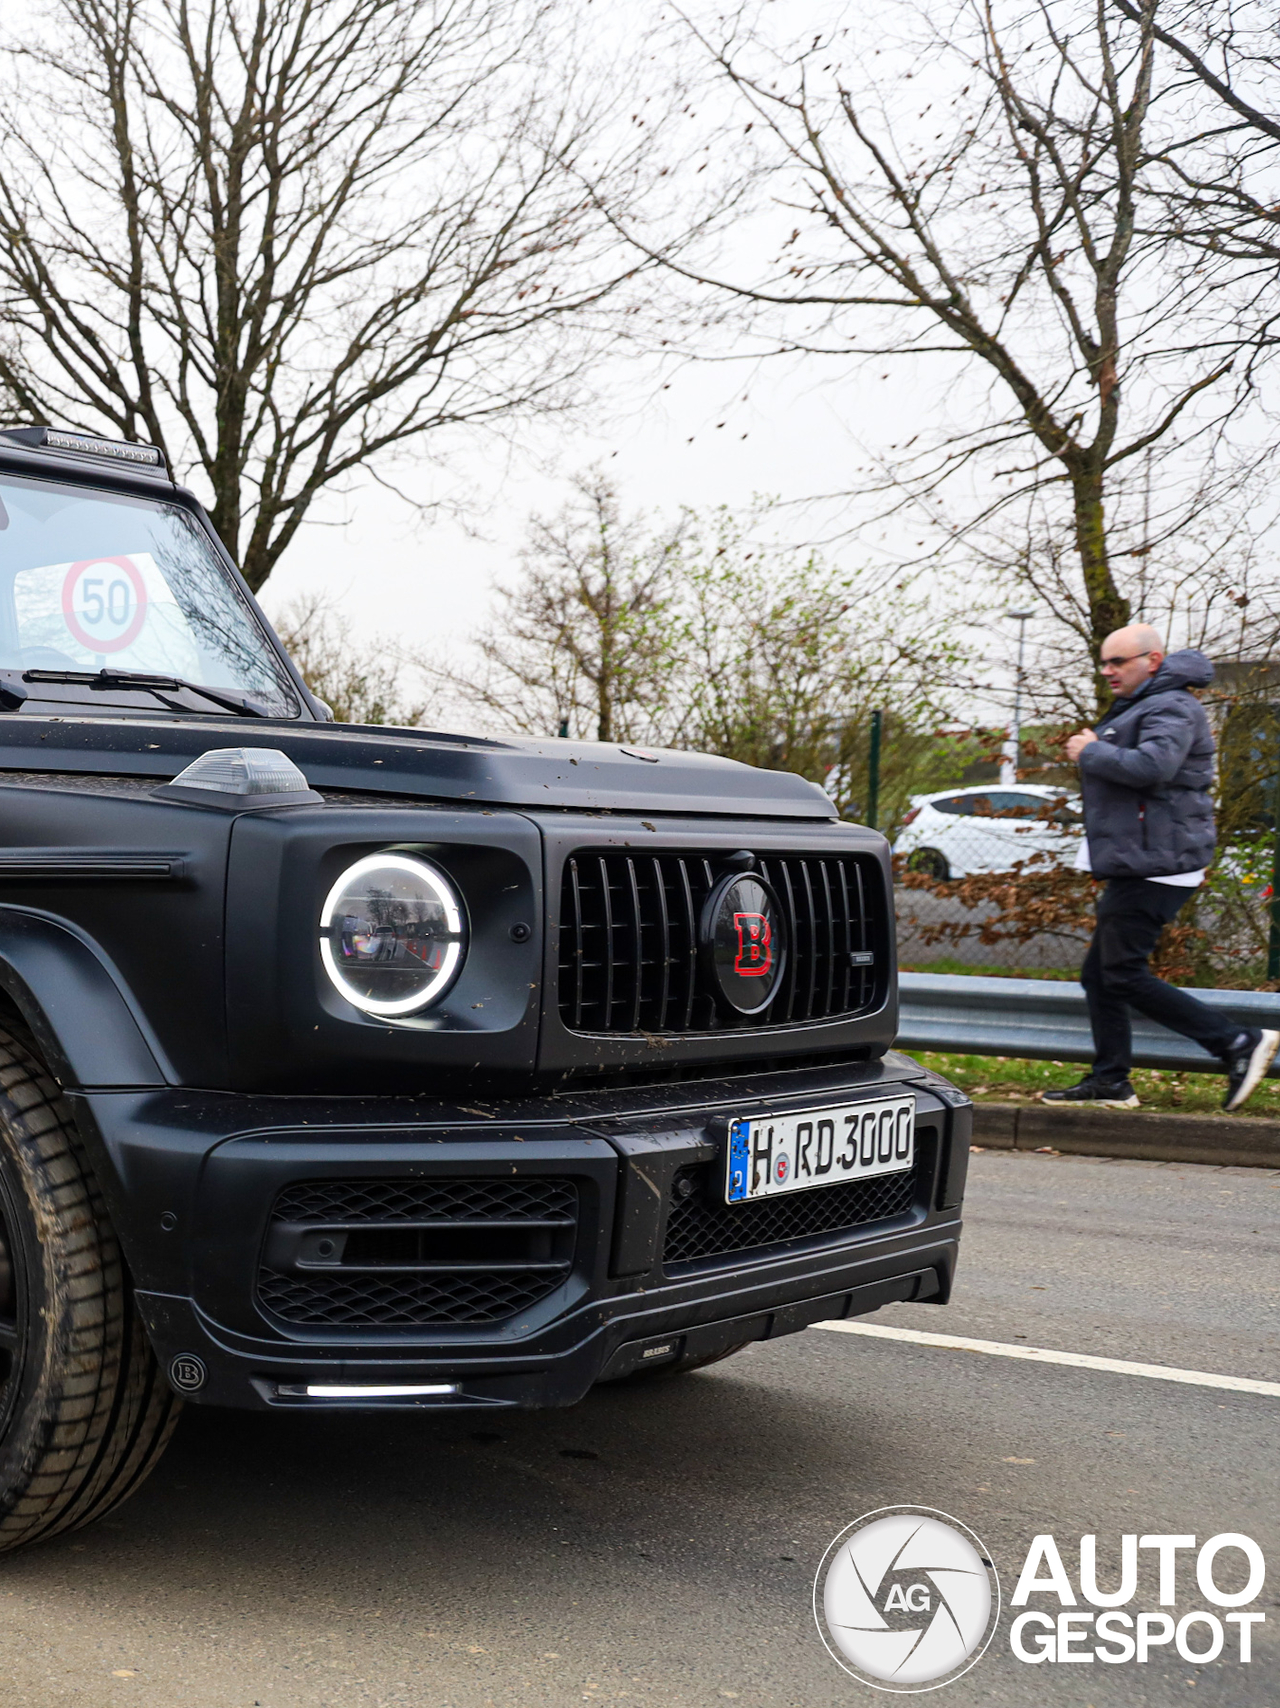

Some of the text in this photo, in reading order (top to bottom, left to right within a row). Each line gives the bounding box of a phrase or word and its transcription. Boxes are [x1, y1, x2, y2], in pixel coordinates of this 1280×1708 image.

[83, 578, 130, 625] 50
[733, 912, 772, 977] B
[752, 1125, 774, 1189] H
[178, 1362, 200, 1384] B
